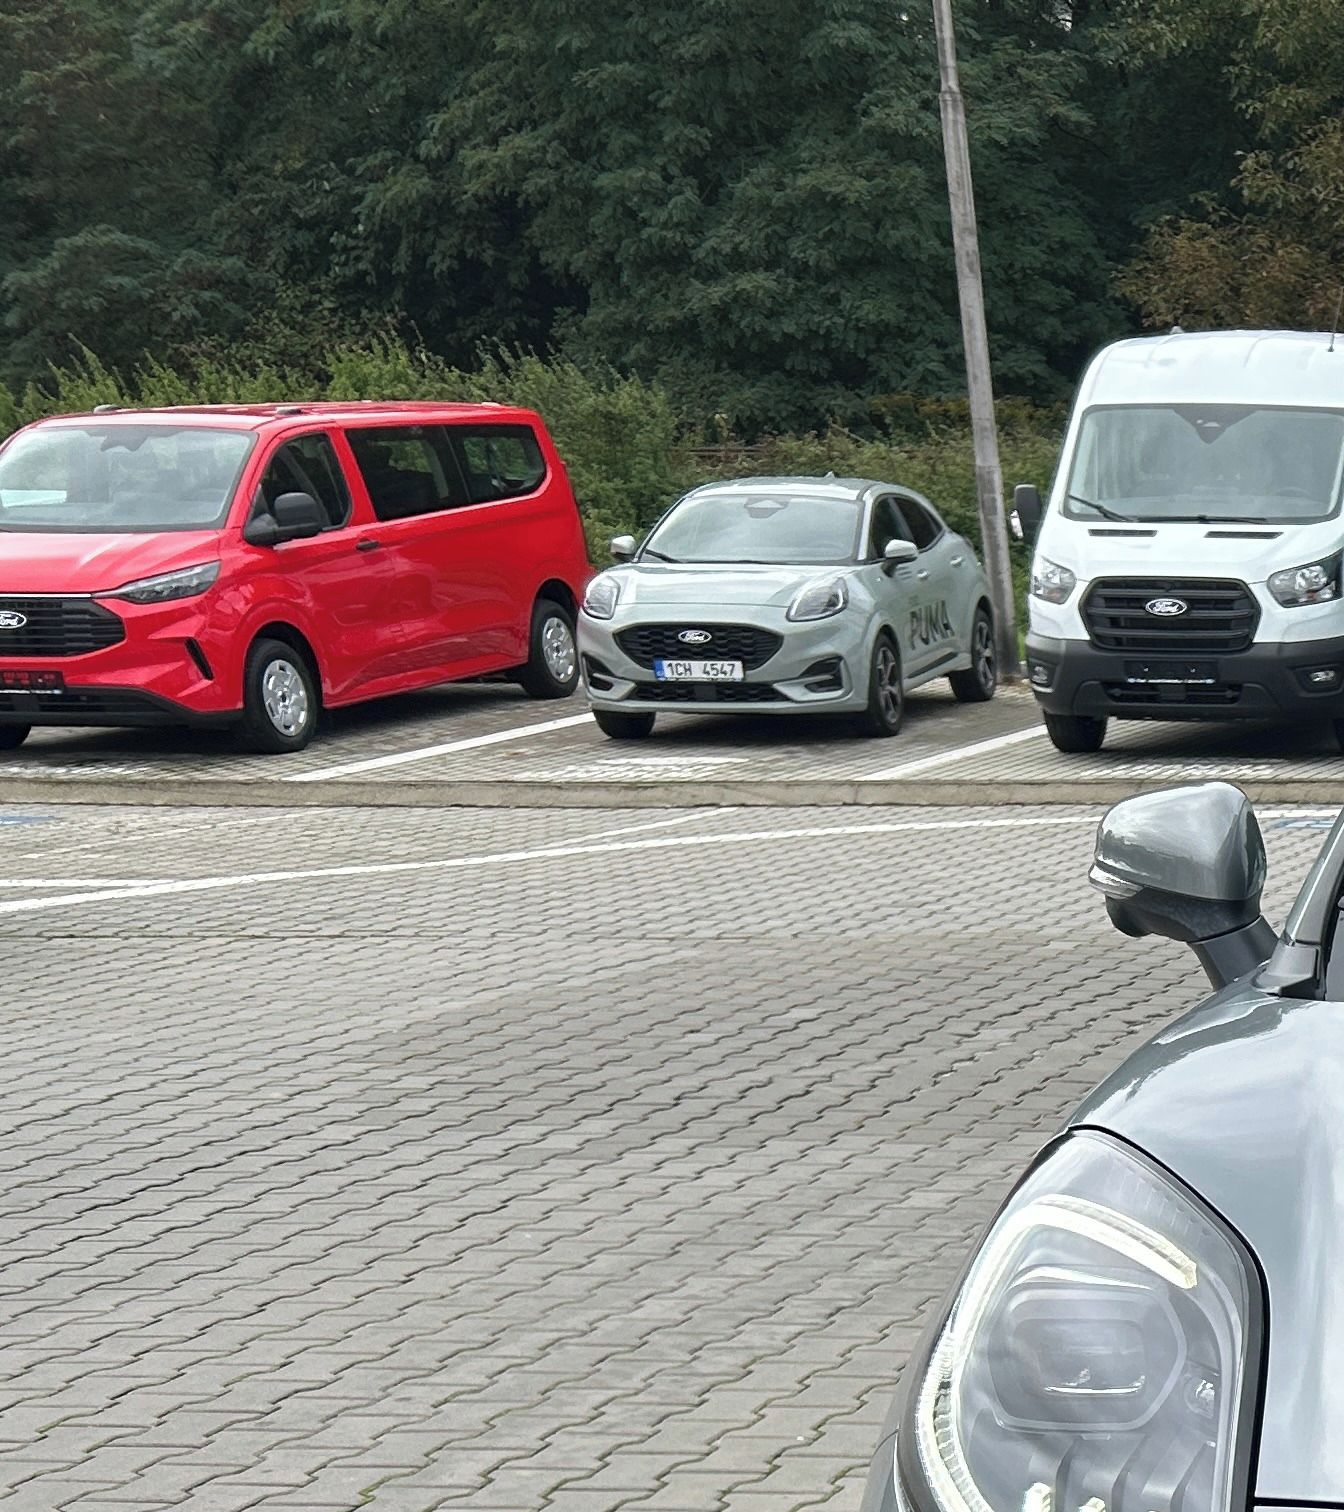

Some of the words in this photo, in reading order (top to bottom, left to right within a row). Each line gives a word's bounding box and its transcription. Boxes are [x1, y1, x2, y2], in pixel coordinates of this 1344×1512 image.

[909, 600, 955, 650] PUMA
[666, 662, 692, 676] 1CH
[702, 663, 736, 677] 4547
